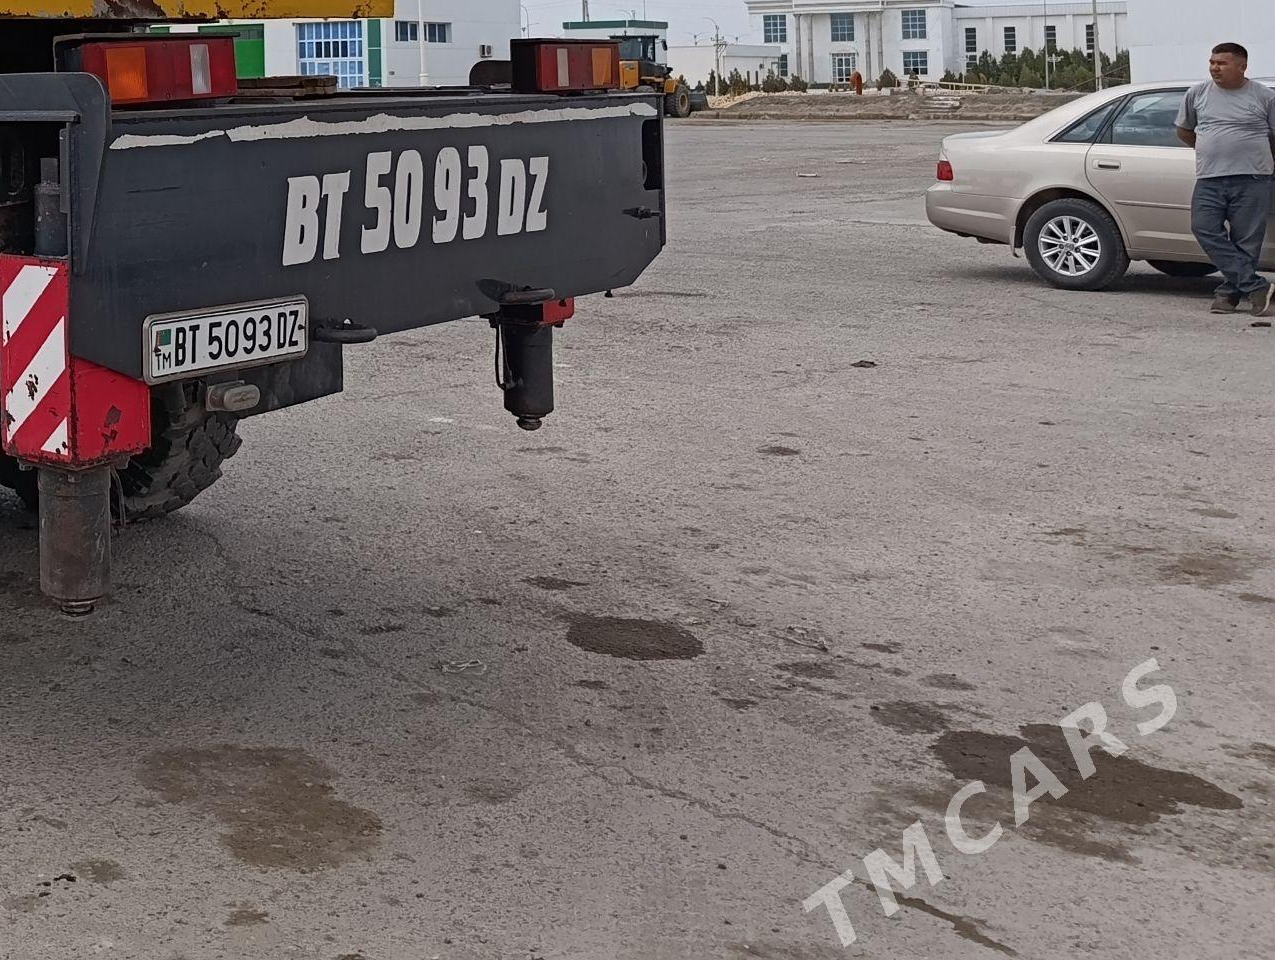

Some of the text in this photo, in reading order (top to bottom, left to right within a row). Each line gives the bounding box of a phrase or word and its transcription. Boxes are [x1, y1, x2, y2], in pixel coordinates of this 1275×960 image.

[282, 170, 351, 266] BT
[497, 155, 550, 236] DZ
[174, 324, 200, 367] BT
[208, 314, 272, 361] 5093
[277, 309, 299, 350] DZ
